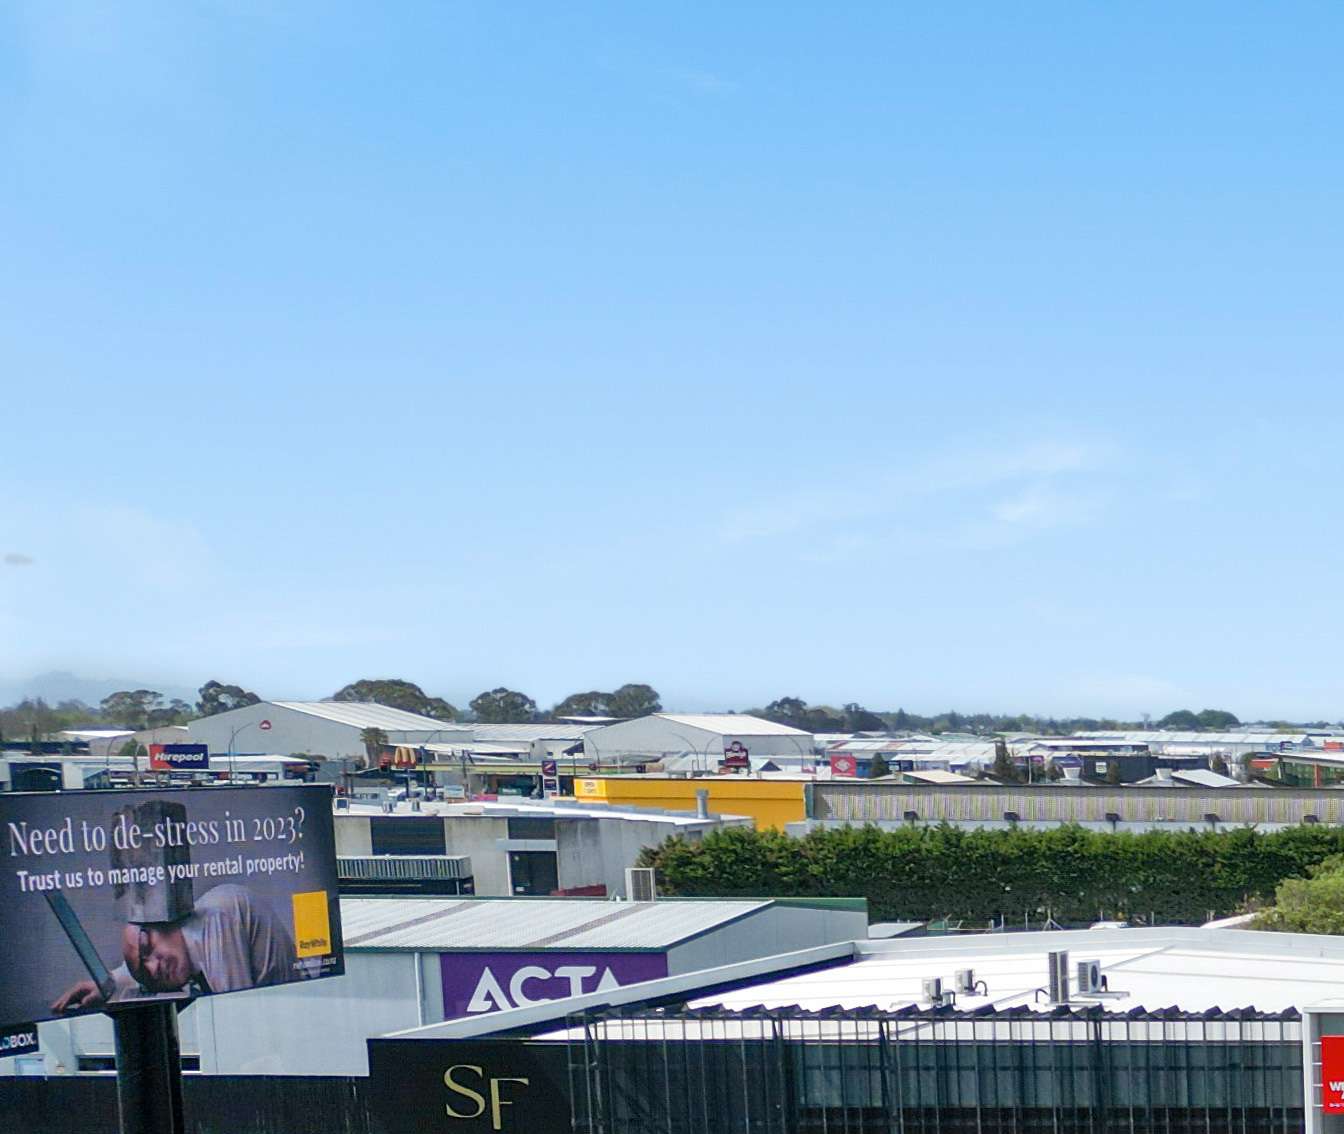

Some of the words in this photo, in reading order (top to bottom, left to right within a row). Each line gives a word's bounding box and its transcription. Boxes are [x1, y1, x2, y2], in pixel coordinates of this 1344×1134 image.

[154, 752, 204, 763] Hirepool
[8, 817, 75, 857] Need
[82, 819, 105, 852] to
[113, 814, 218, 850] de-stress
[225, 811, 246, 843] in
[253, 806, 305, 845] 2023?
[17, 870, 61, 892] Trust
[66, 872, 84, 889] us
[88, 869, 104, 886] to
[108, 866, 165, 889] manage
[168, 863, 201, 886] your
[203, 855, 243, 876] rental
[246, 851, 305, 875] property!
[443, 1064, 529, 1130] SF
